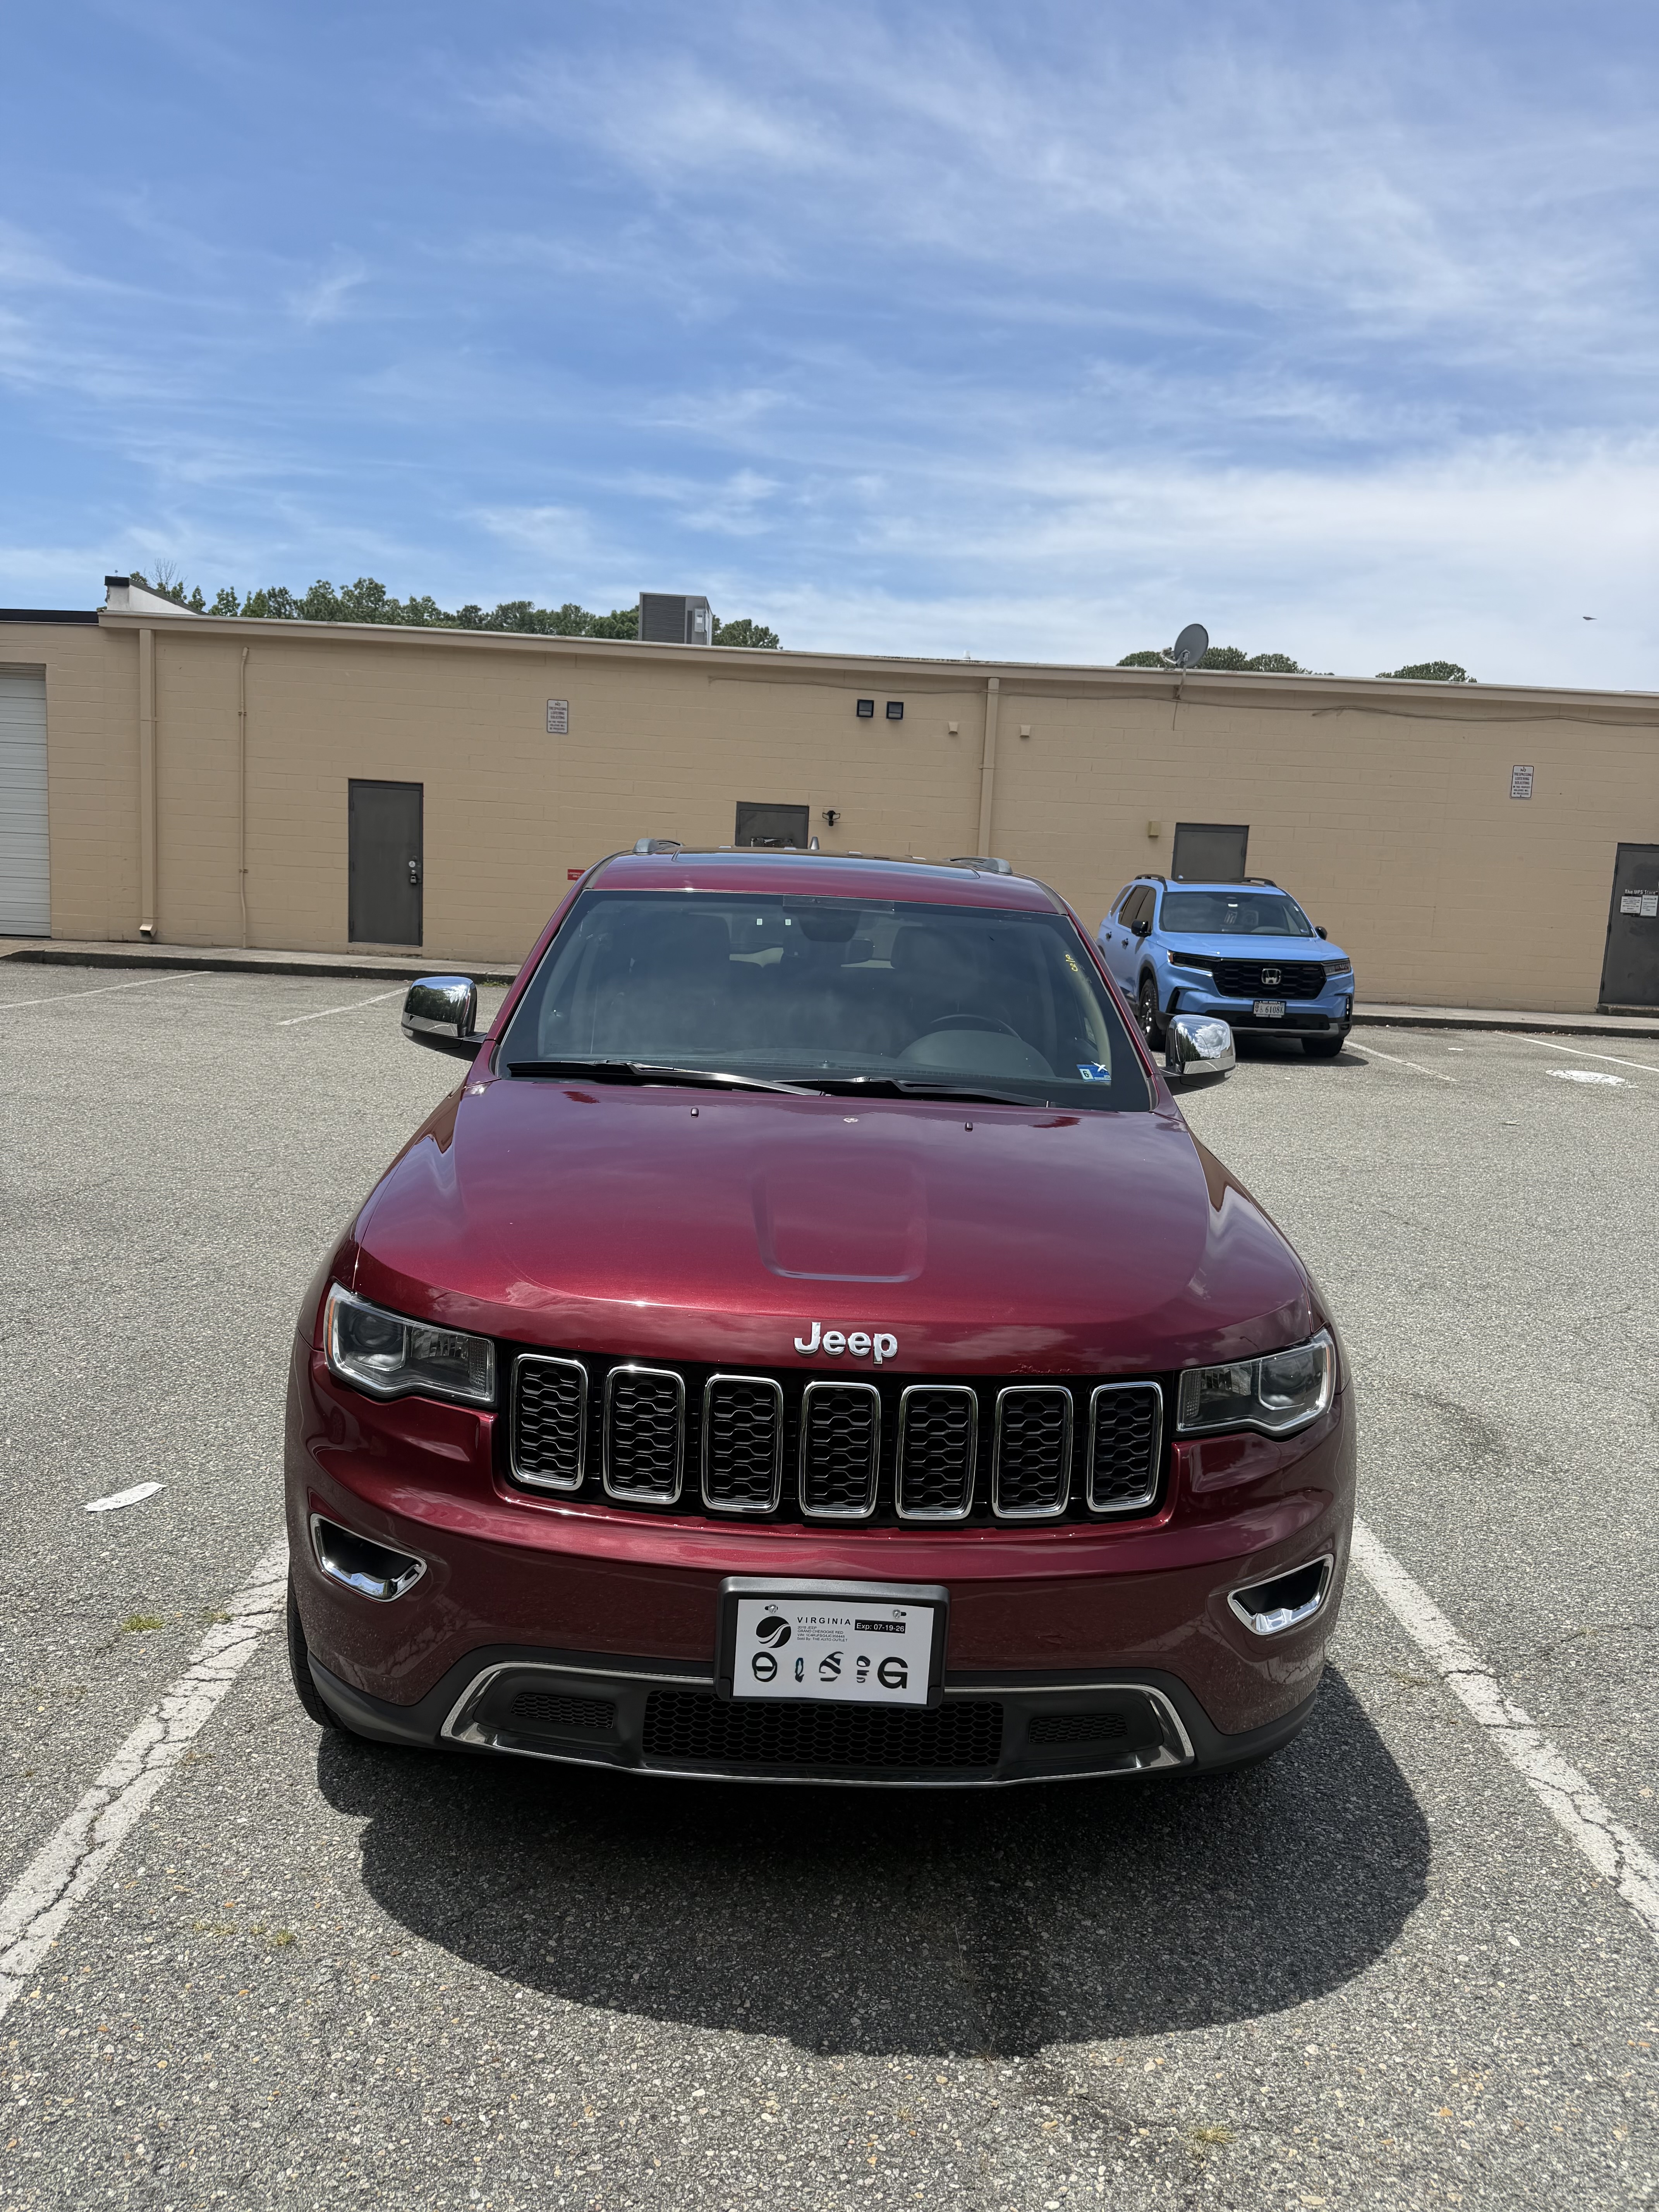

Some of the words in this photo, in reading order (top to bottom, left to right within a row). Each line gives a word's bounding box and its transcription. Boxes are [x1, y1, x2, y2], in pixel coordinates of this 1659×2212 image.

[794, 1321, 898, 1364] Jeep
[797, 1617, 851, 1625] VIRGINIA
[857, 1623, 872, 1631] Exp:
[874, 1624, 905, 1632] 07-19-26
